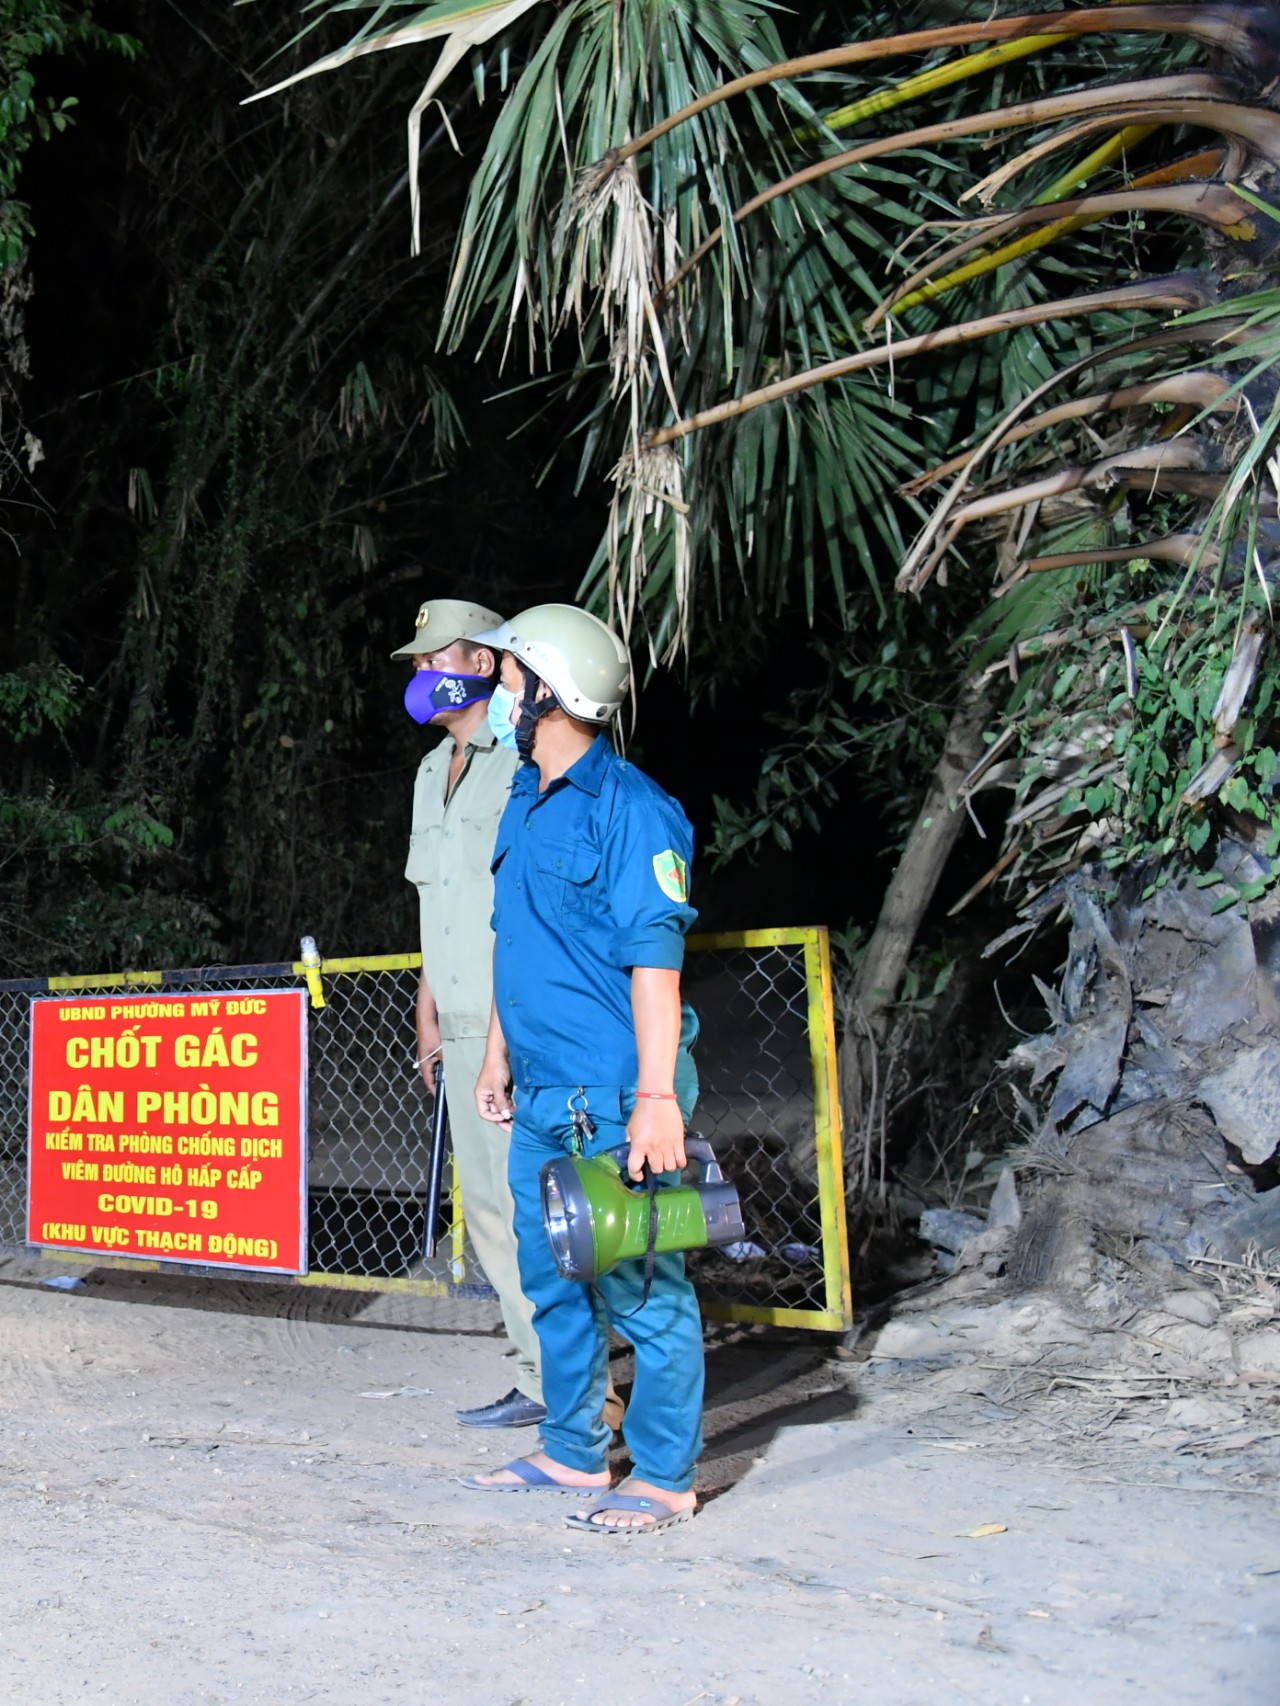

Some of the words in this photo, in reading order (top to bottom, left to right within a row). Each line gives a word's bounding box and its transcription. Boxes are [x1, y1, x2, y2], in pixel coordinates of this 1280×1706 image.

[59, 1006, 106, 1021] UBND
[110, 1001, 185, 1020] PHƯỜNG
[191, 999, 219, 1017] MỸ
[226, 997, 267, 1016] ĐỨC
[66, 1025, 162, 1068] CHỐT
[175, 1027, 258, 1068] GÁC
[48, 1084, 124, 1122] DÂN
[137, 1083, 279, 1126] PHÒNG
[45, 1126, 83, 1151] KIỂM
[87, 1133, 115, 1152] TRA
[119, 1131, 173, 1155] PHÒNG
[178, 1131, 236, 1157] CHỐNG
[241, 1137, 282, 1161] DỊCH
[62, 1159, 99, 1181] VIÊM
[102, 1161, 156, 1184] ĐƯỜNG
[161, 1164, 183, 1186] HÔ
[187, 1162, 221, 1188] HẤP
[227, 1164, 262, 1189] CẤP
[98, 1193, 218, 1220] COVID-19
[42, 1223, 86, 1240] (KHU
[92, 1226, 129, 1248] VỰC
[135, 1230, 202, 1254] THẠCH
[208, 1233, 278, 1260] ĐỘNG)
